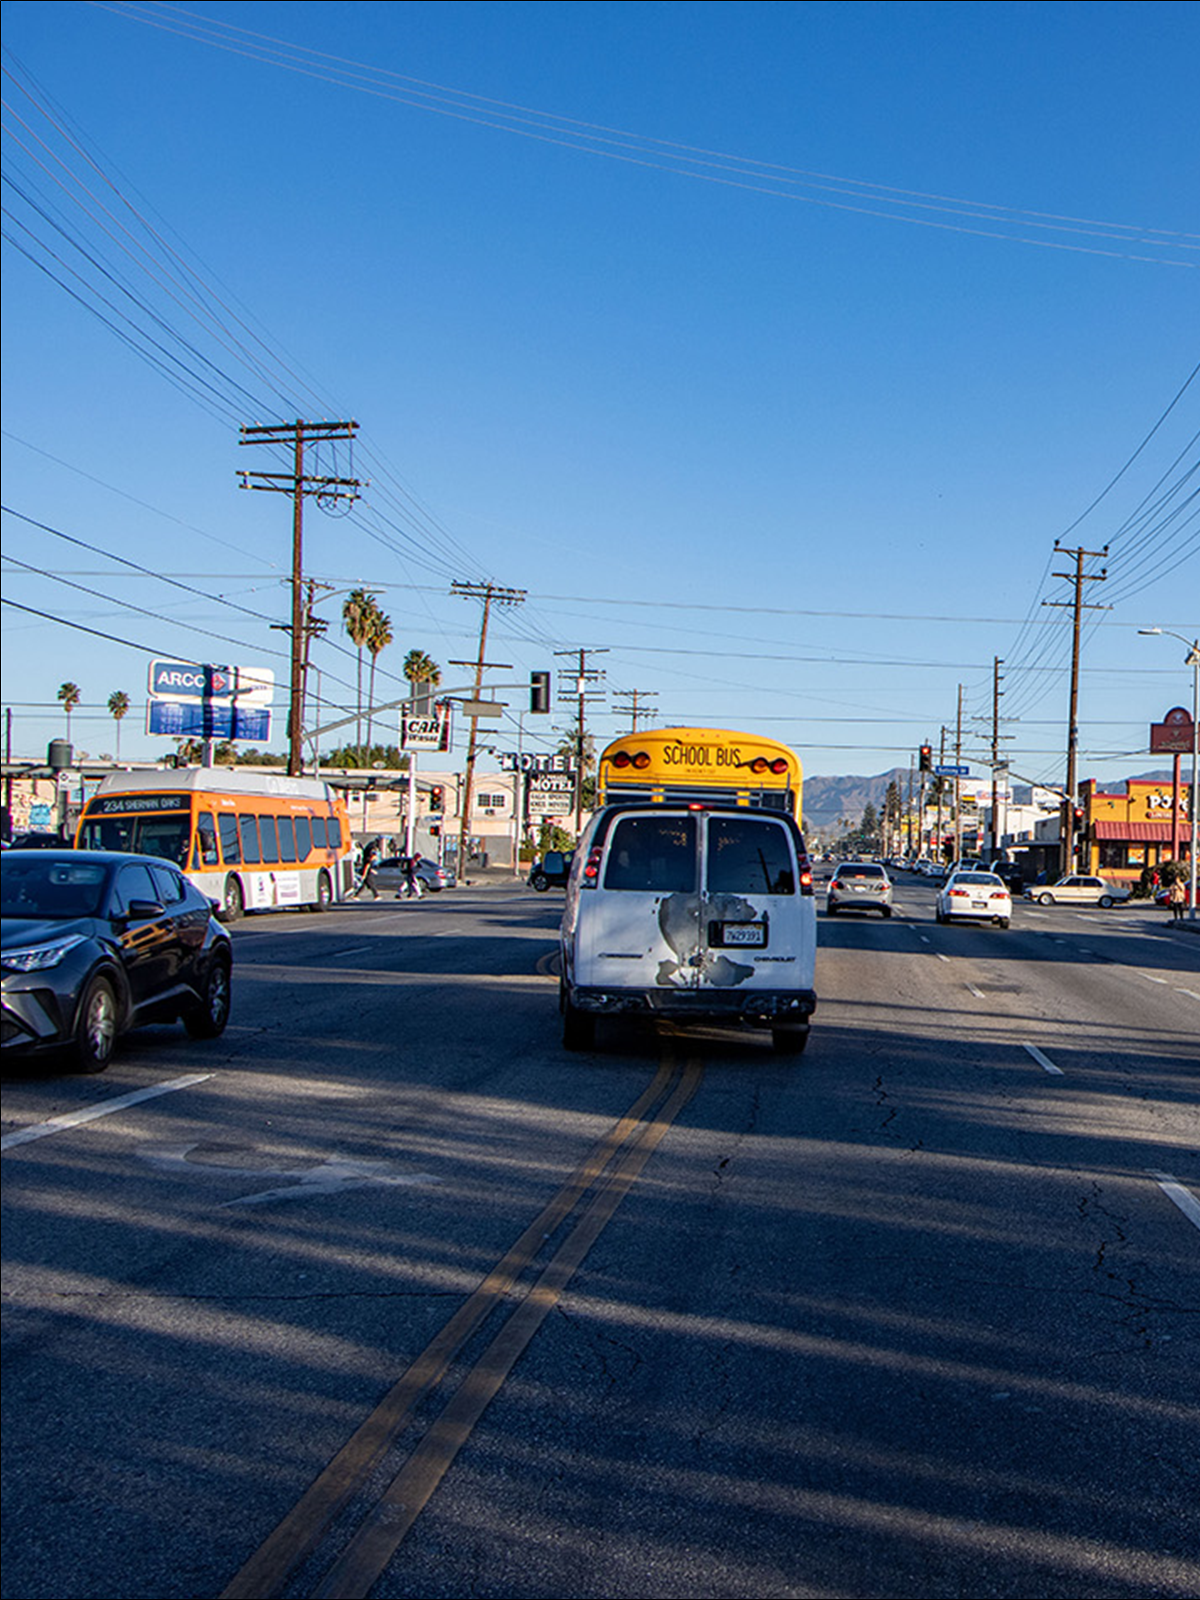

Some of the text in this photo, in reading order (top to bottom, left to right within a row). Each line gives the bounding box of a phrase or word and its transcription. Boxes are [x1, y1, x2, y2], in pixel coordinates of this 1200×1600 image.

[157, 671, 206, 688] ARCO
[408, 720, 440, 733] CAR
[501, 754, 578, 772] MOTEL
[663, 745, 741, 768] SCHOOL BUS
[530, 779, 575, 792] MOTEL
[103, 799, 124, 812] 234
